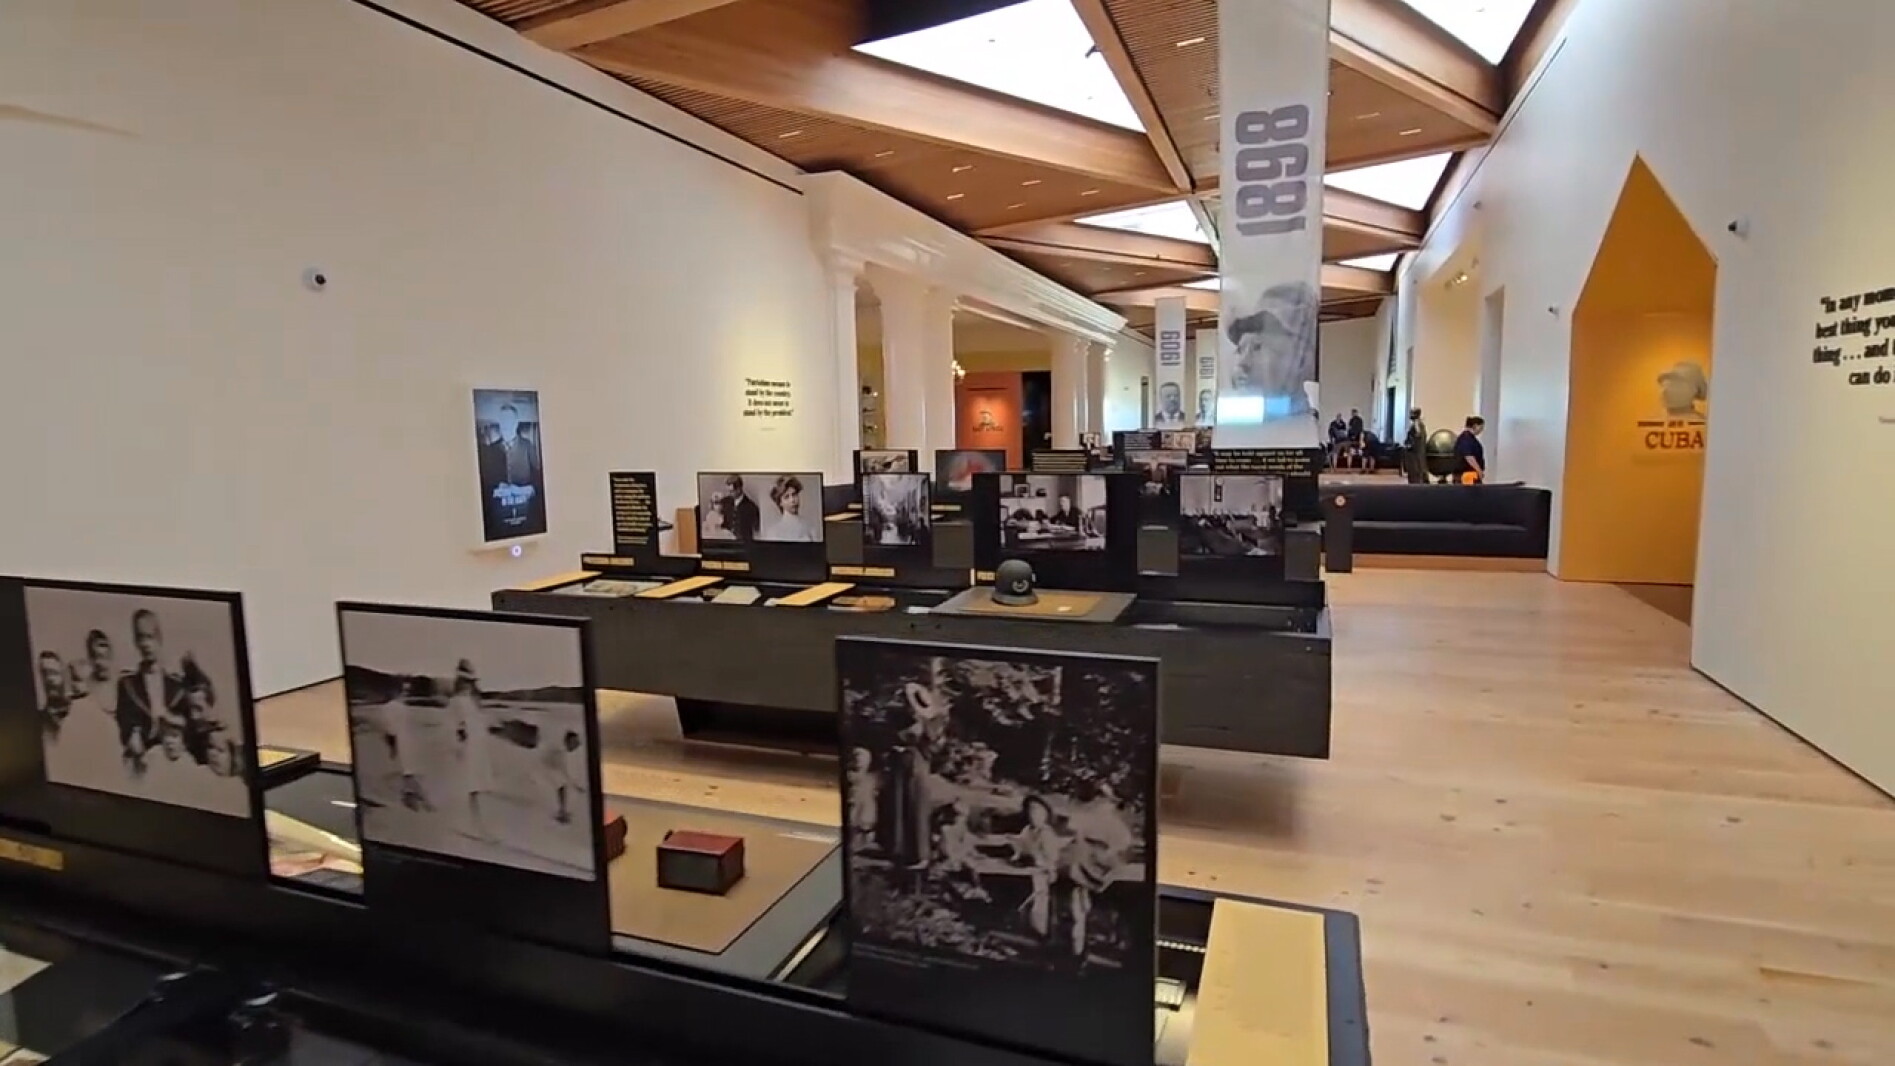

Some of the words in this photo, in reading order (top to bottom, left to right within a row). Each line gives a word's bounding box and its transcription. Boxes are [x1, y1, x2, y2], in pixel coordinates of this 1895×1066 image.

[1236, 104, 1309, 236] 1898
[1838, 294, 1861, 313] any
[1815, 321, 1838, 339] best
[1840, 316, 1871, 337] thing
[1160, 331, 1181, 366] 1909
[1863, 338, 1889, 358] and
[1849, 372, 1870, 385] can
[1873, 366, 1891, 384] do
[1645, 431, 1705, 450] CUBA
